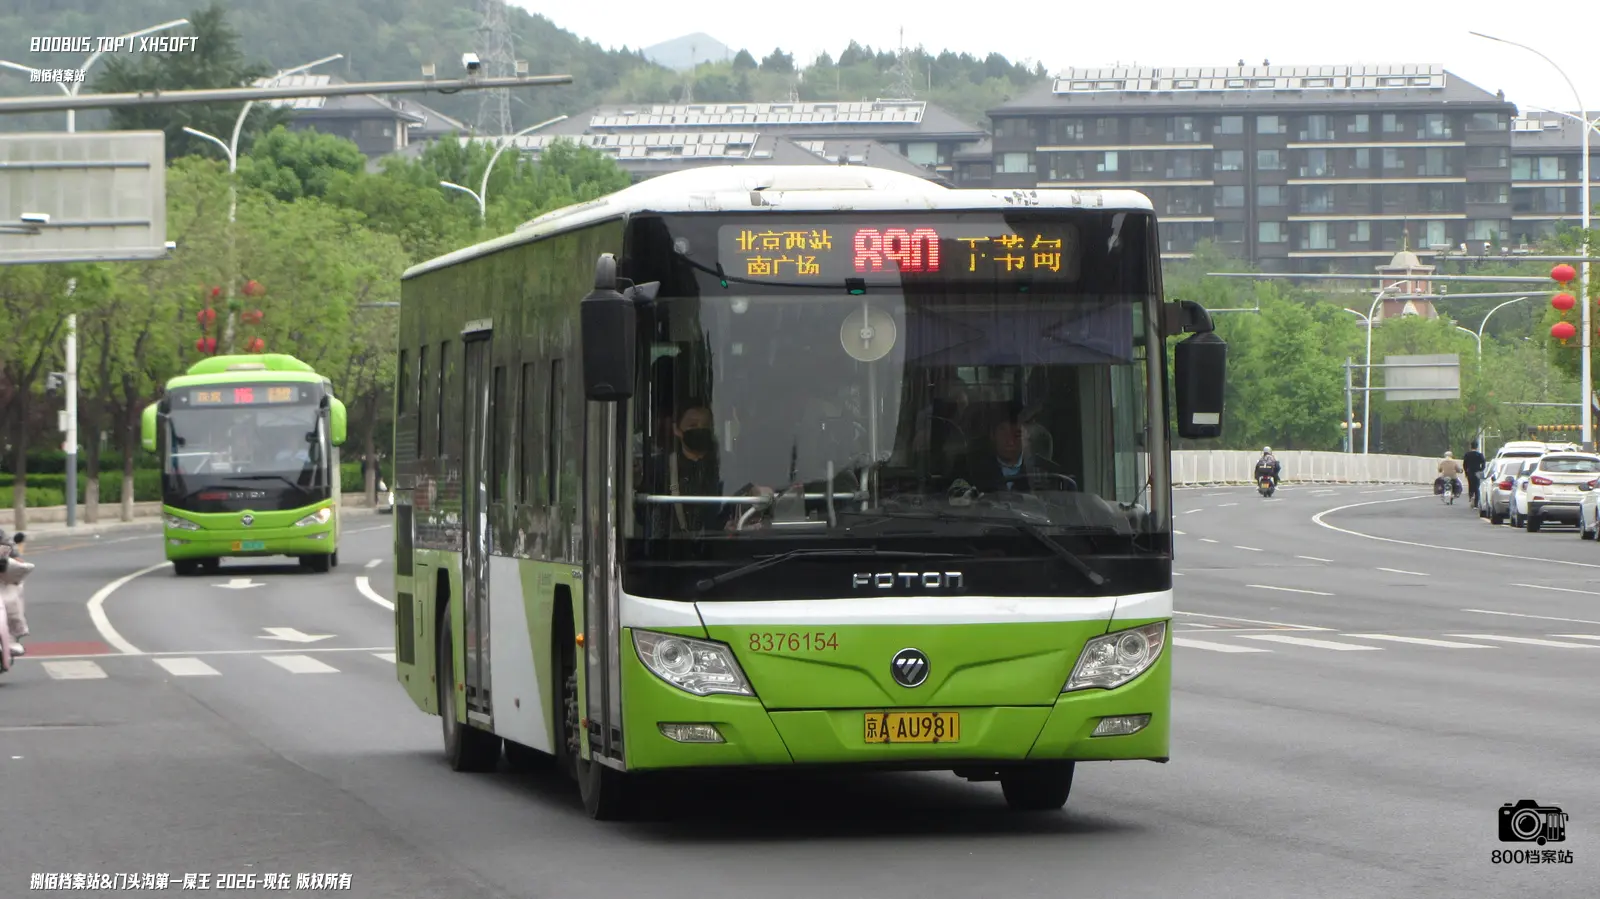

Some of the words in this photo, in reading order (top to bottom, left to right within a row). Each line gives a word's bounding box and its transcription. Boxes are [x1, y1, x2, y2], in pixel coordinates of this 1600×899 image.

[735, 229, 833, 251] 北京西站
[746, 254, 820, 275] 南广场
[852, 571, 964, 589] FOTON
[749, 632, 839, 652] 8376154
